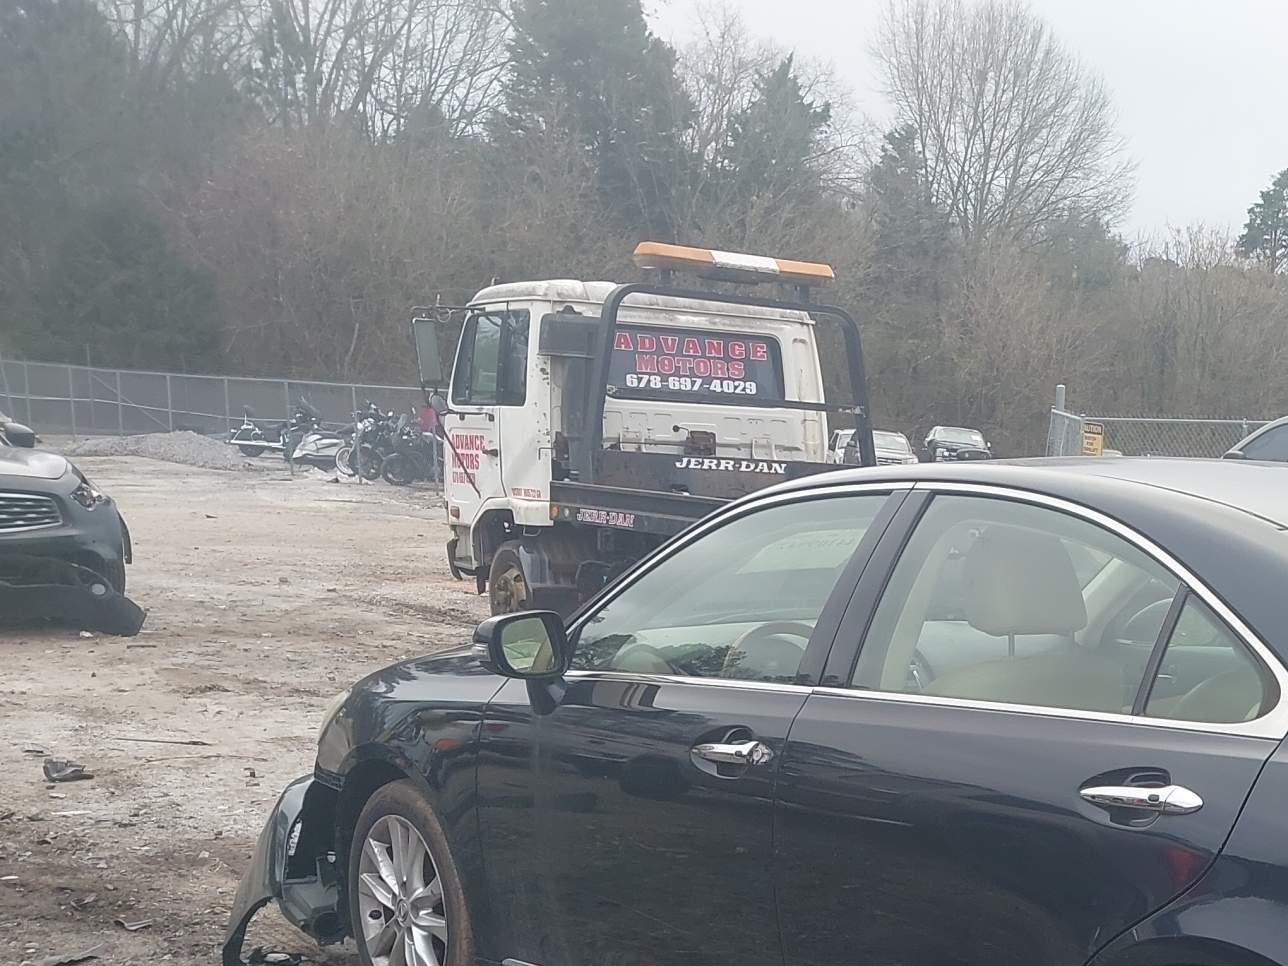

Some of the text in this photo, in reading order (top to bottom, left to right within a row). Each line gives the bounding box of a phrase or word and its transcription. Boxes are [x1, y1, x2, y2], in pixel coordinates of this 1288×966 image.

[614, 332, 767, 361] ADVANCE
[635, 353, 746, 379] MOTORS
[625, 374, 757, 395] 678-697-4029
